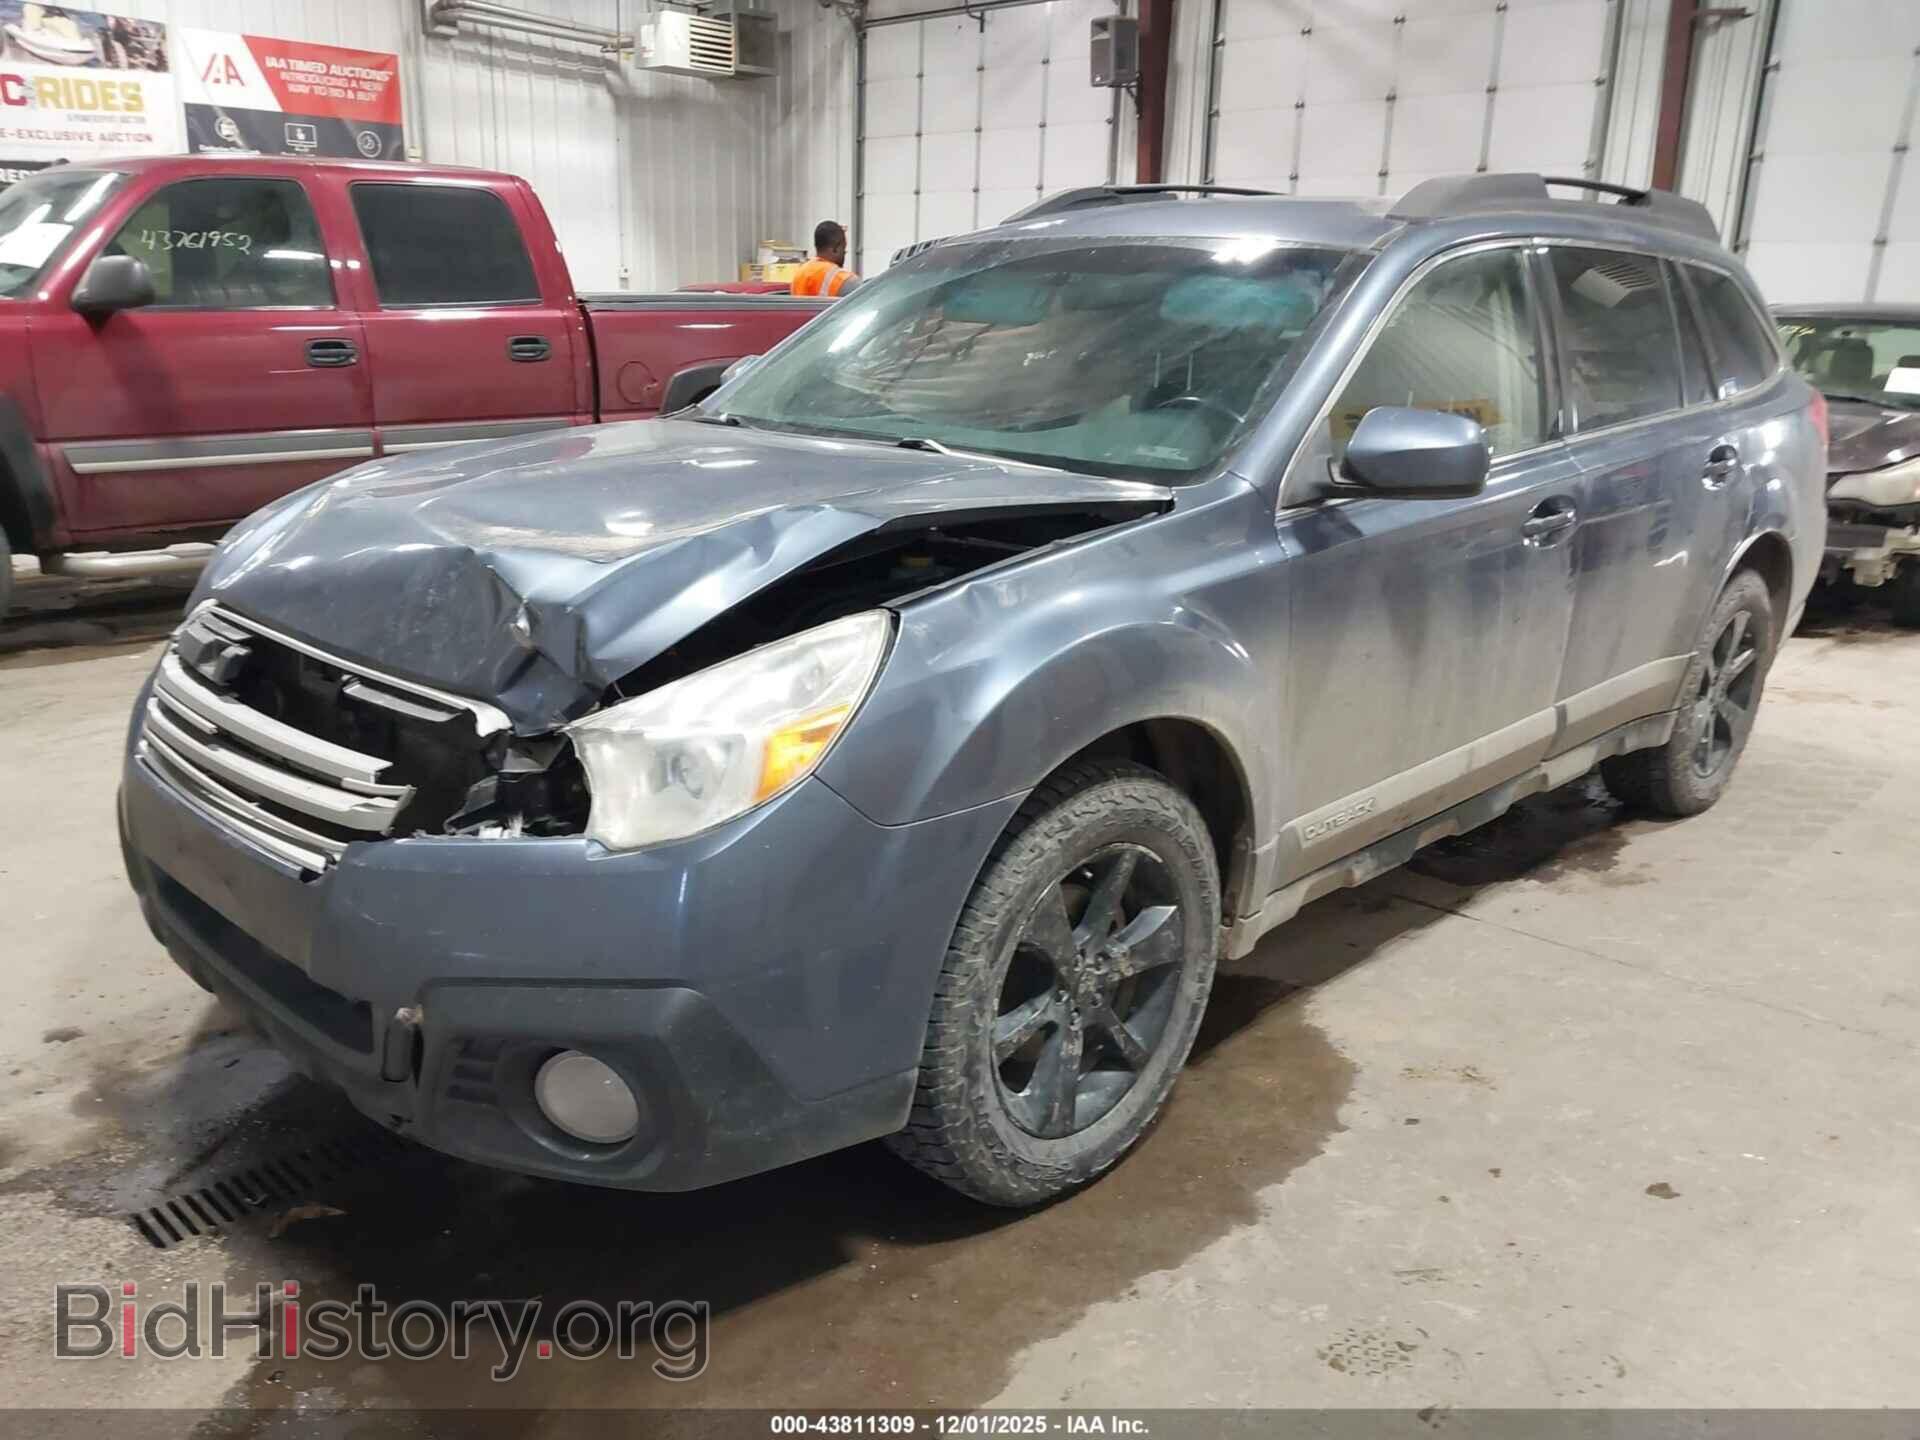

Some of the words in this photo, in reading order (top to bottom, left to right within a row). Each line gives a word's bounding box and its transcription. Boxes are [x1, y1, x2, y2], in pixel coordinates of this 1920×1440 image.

[288, 59, 327, 74] TIMED
[34, 76, 144, 112] RIDES
[99, 131, 153, 142] AUCTION
